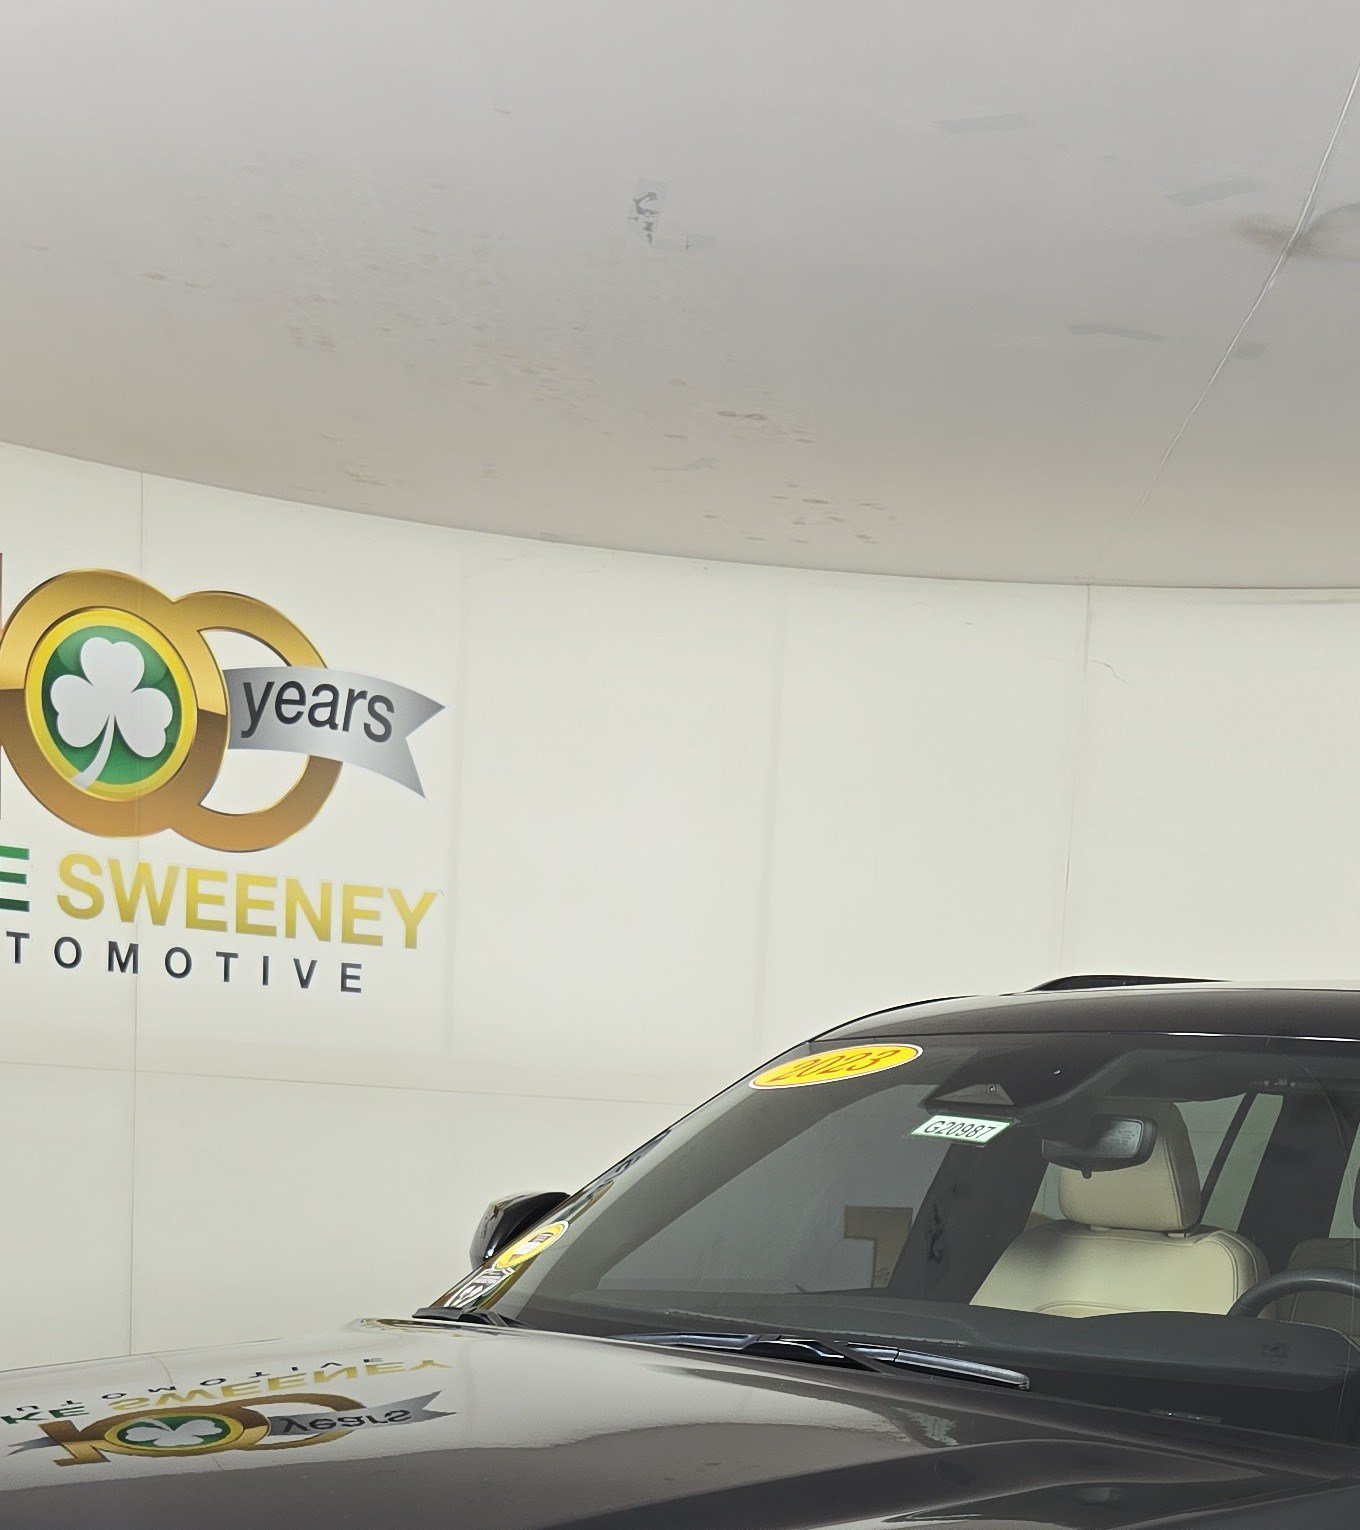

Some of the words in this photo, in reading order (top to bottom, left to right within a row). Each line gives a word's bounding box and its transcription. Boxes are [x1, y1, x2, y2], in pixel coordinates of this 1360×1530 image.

[242, 677, 396, 743] years
[57, 853, 440, 950] SWEENEY
[766, 1048, 902, 1083] 2023
[924, 1119, 994, 1142] G20987
